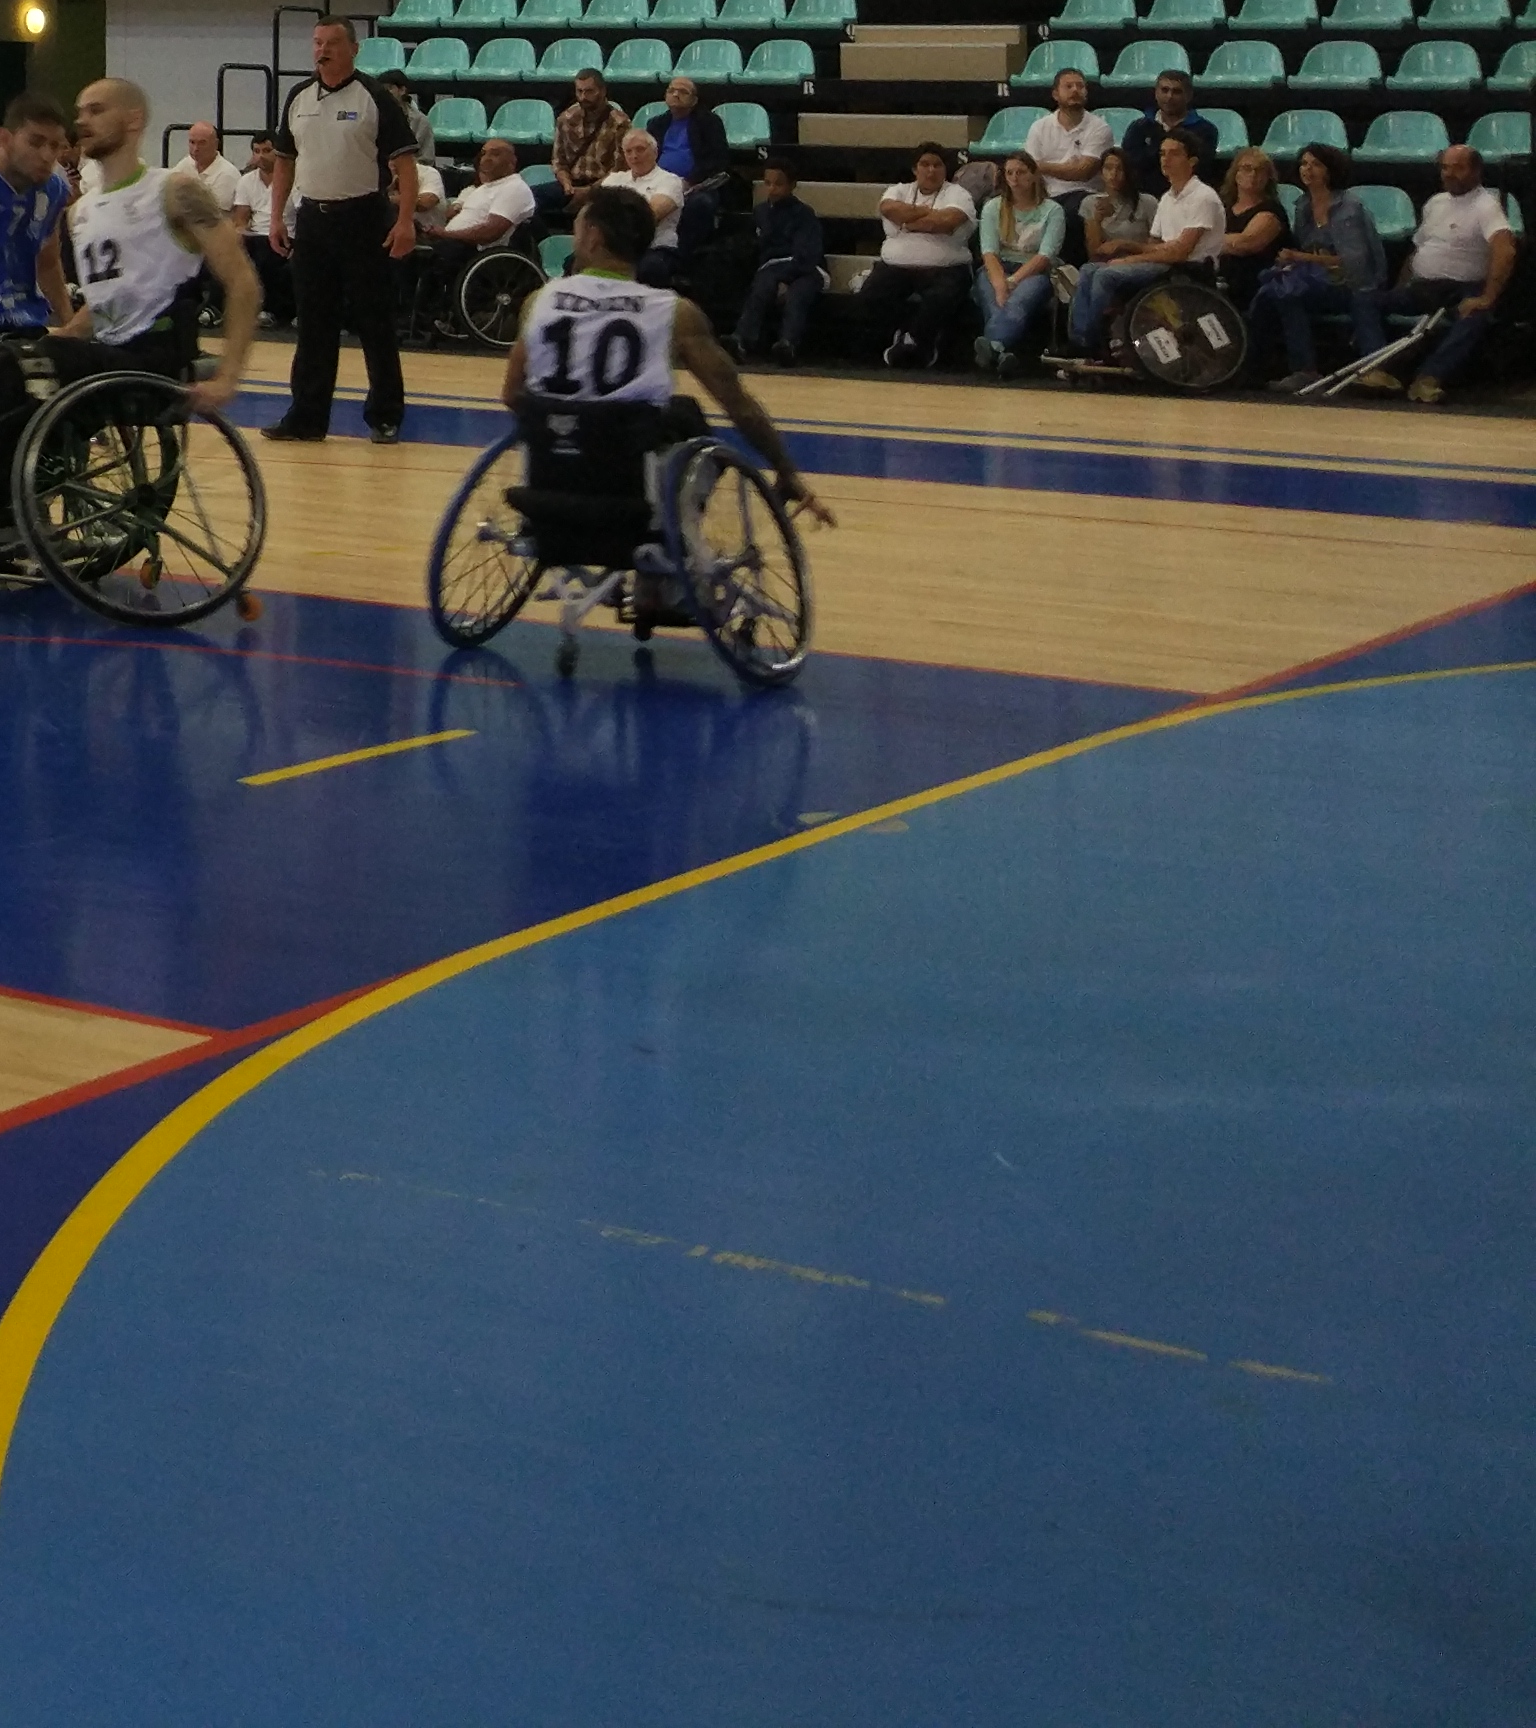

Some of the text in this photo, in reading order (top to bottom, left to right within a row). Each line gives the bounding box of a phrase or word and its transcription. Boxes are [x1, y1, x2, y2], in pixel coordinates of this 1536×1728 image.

[803, 80, 815, 96] R
[997, 81, 1010, 97] R
[82, 238, 124, 285] 12
[539, 315, 645, 396] 10
